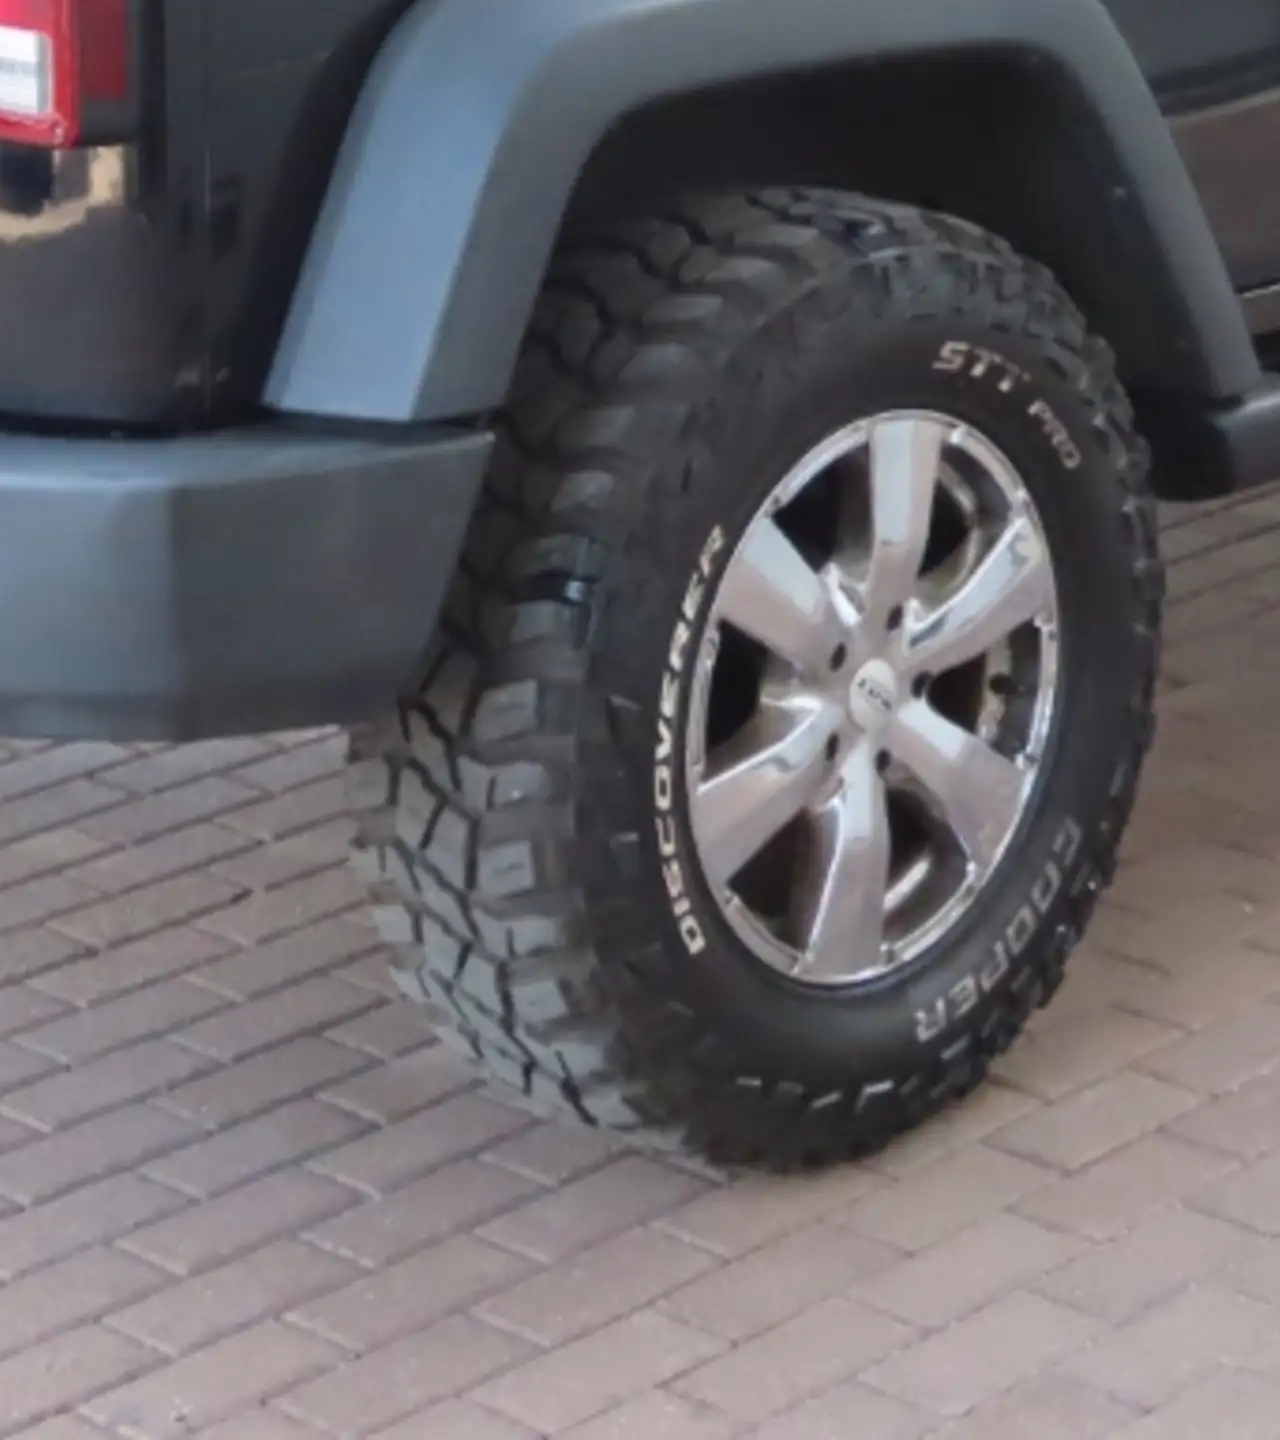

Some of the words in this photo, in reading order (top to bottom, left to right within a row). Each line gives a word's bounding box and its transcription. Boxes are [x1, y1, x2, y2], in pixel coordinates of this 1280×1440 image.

[931, 339, 1033, 394] STT
[1026, 400, 1082, 470] PRO
[654, 524, 725, 956] DISCOVERER
[915, 817, 1082, 1043] COOPER
